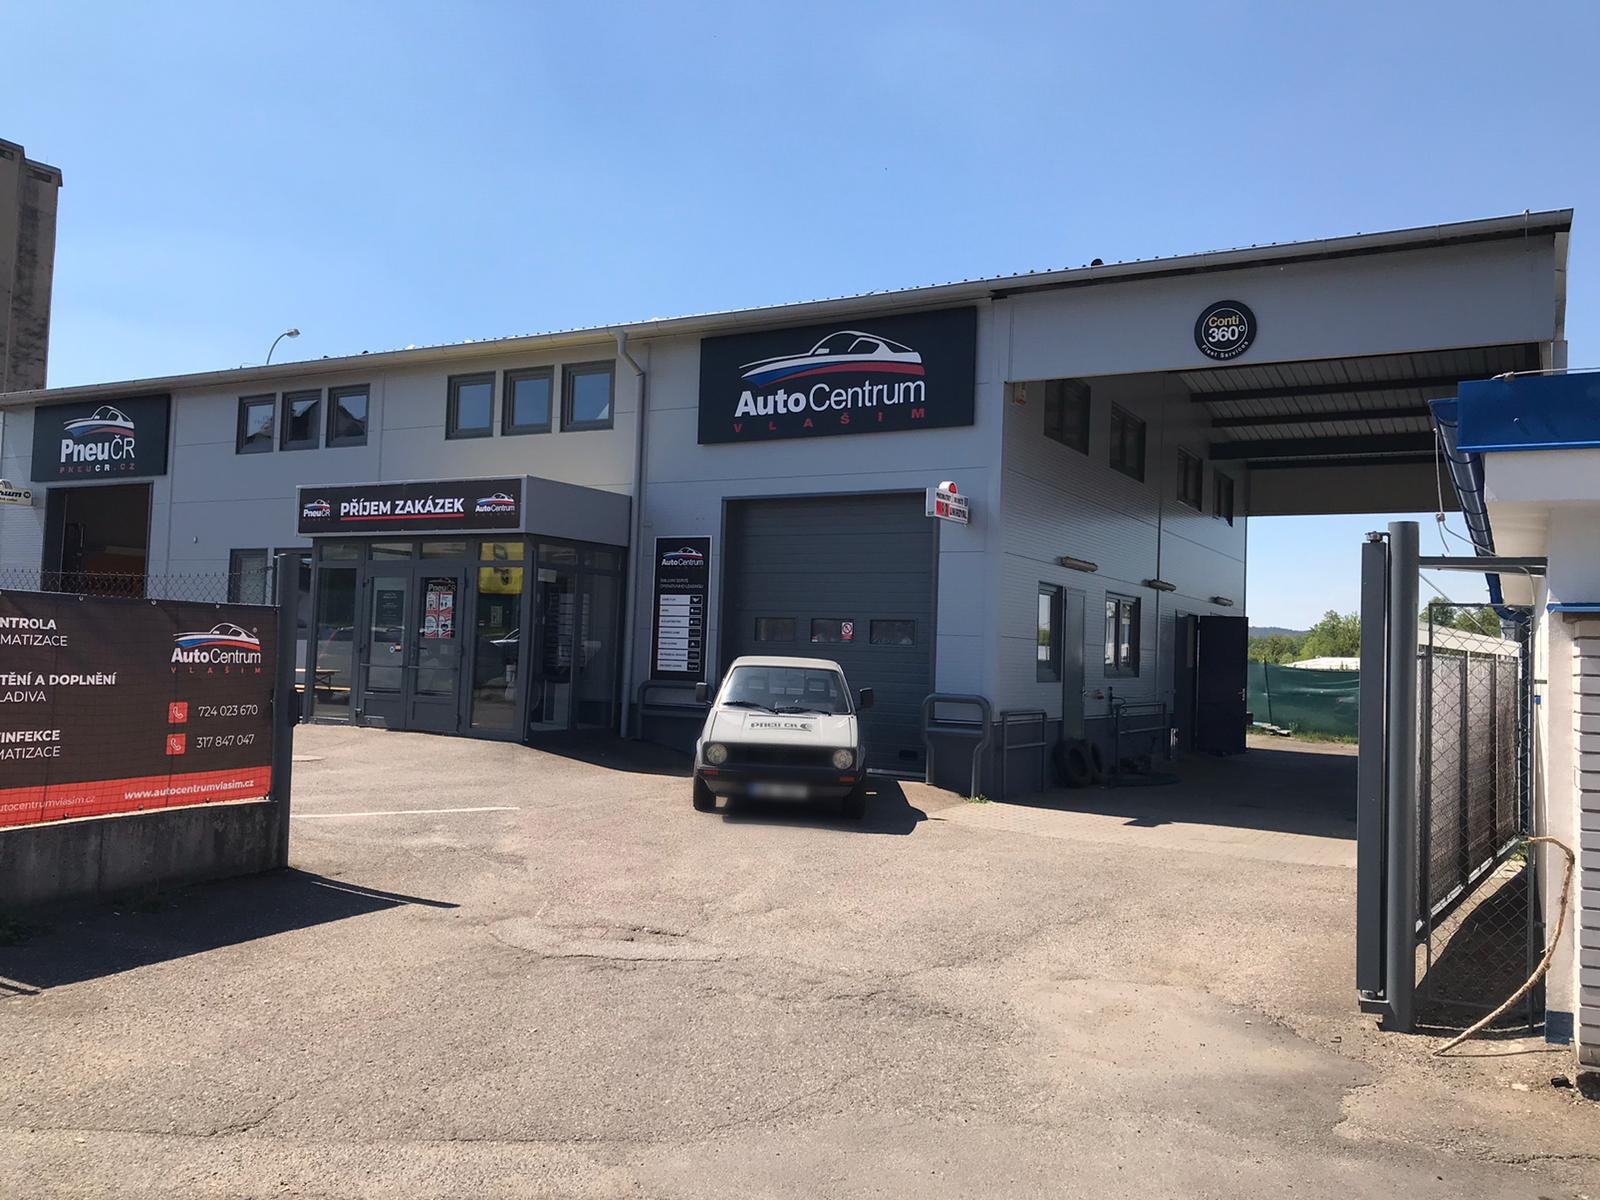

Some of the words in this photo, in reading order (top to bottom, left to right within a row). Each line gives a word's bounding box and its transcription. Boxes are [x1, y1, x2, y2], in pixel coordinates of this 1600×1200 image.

[1209, 315, 1239, 327] Conti
[734, 380, 926, 418] AutoCentrum
[60, 434, 136, 463] PneuČR
[340, 498, 391, 517] PŘÍJEM
[394, 496, 465, 515] ZAKÁZEK
[475, 503, 516, 513] AutoCentrum
[661, 558, 704, 566] AutoCentrum
[171, 648, 262, 664] AutoCentrum
[34, 674, 46, 686] A
[49, 672, 117, 686] DOPLNĚNÍ
[198, 706, 218, 718] 724
[219, 705, 238, 717] 023
[240, 704, 258, 716] 670
[0, 730, 61, 743] INFEKCE
[196, 737, 213, 749] 317
[215, 736, 235, 748] 847
[236, 734, 255, 746] 047
[124, 779, 254, 800] www.autocentrumvlasim.cz
